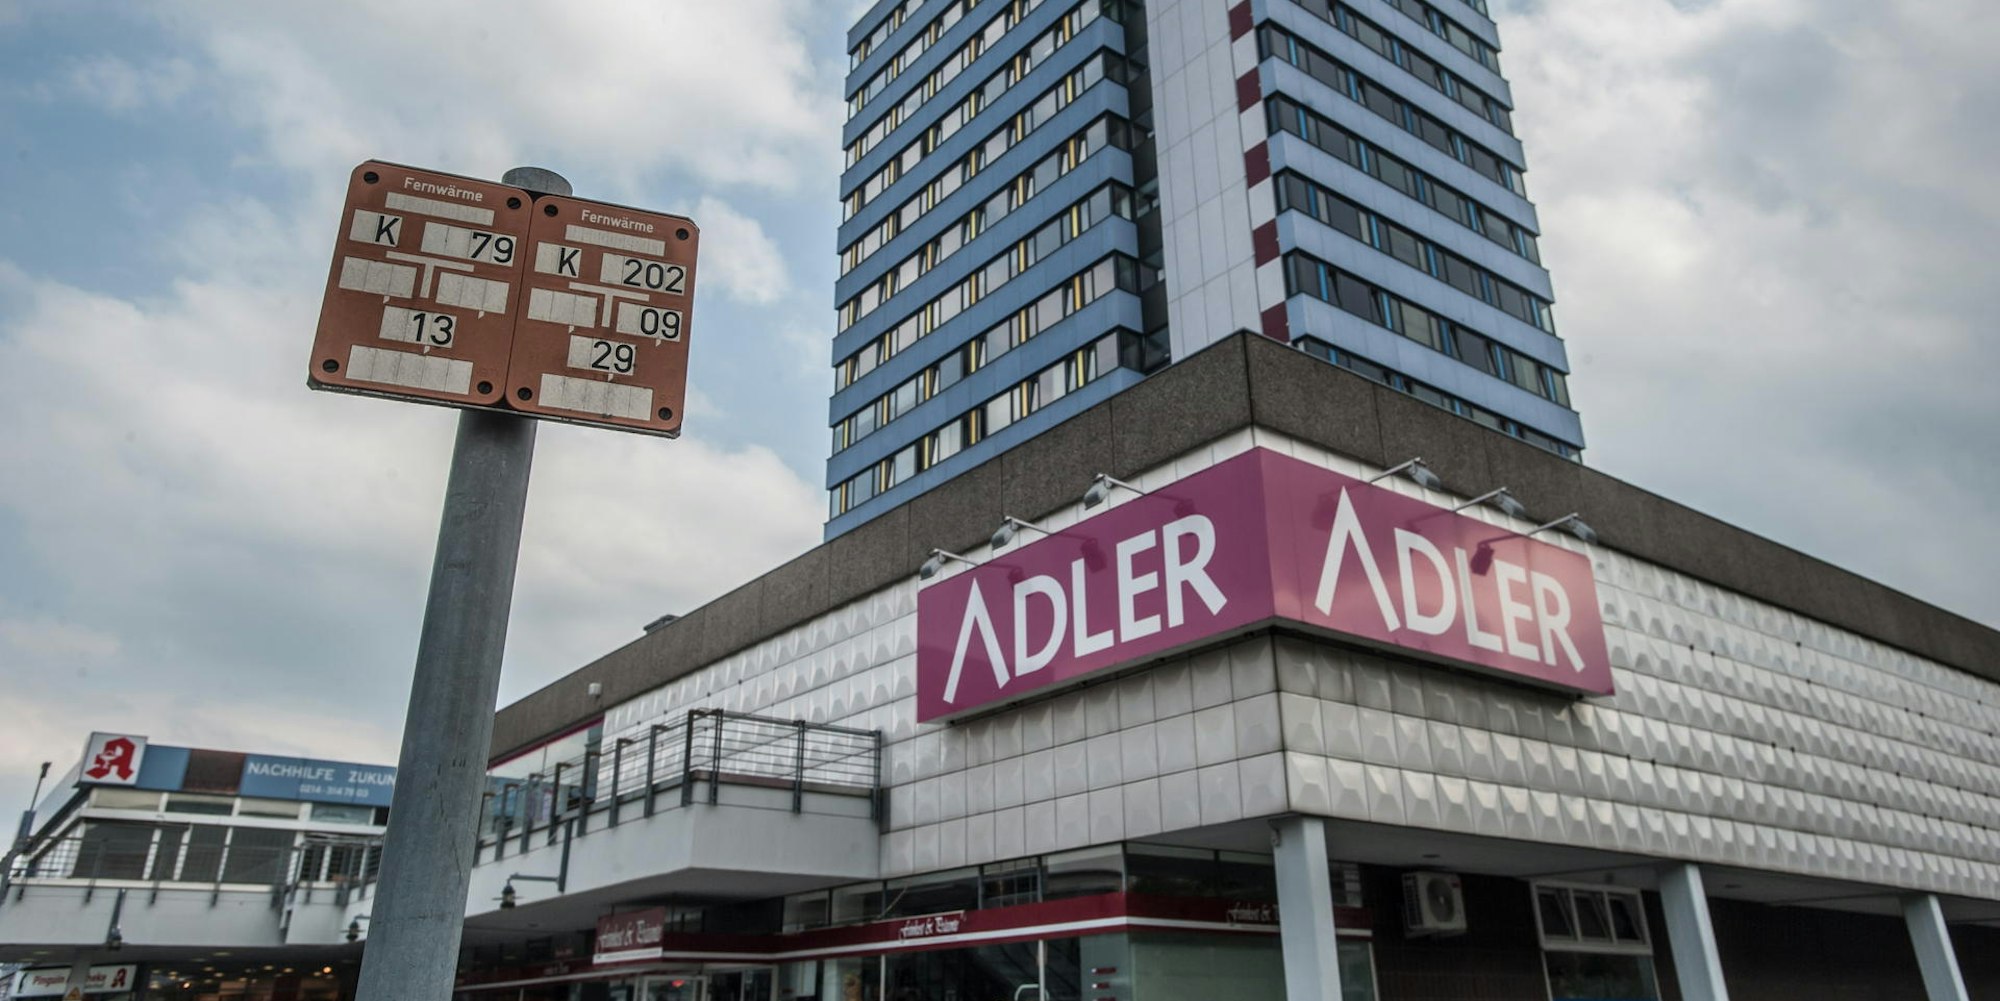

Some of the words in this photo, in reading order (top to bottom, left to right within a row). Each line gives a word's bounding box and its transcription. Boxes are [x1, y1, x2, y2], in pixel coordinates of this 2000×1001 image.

[404, 177, 483, 202] Fernwärme
[581, 209, 654, 233] Fernwärme
[374, 215, 400, 246] K
[468, 232, 515, 264] 79
[557, 247, 580, 277] K
[623, 258, 685, 294] 202
[411, 306, 454, 345] 13
[639, 308, 681, 339] 09
[590, 340, 634, 374] 29
[1315, 486, 1586, 672] ADLER
[943, 514, 1228, 704] ADLER
[247, 762, 336, 782] NACHHILFE
